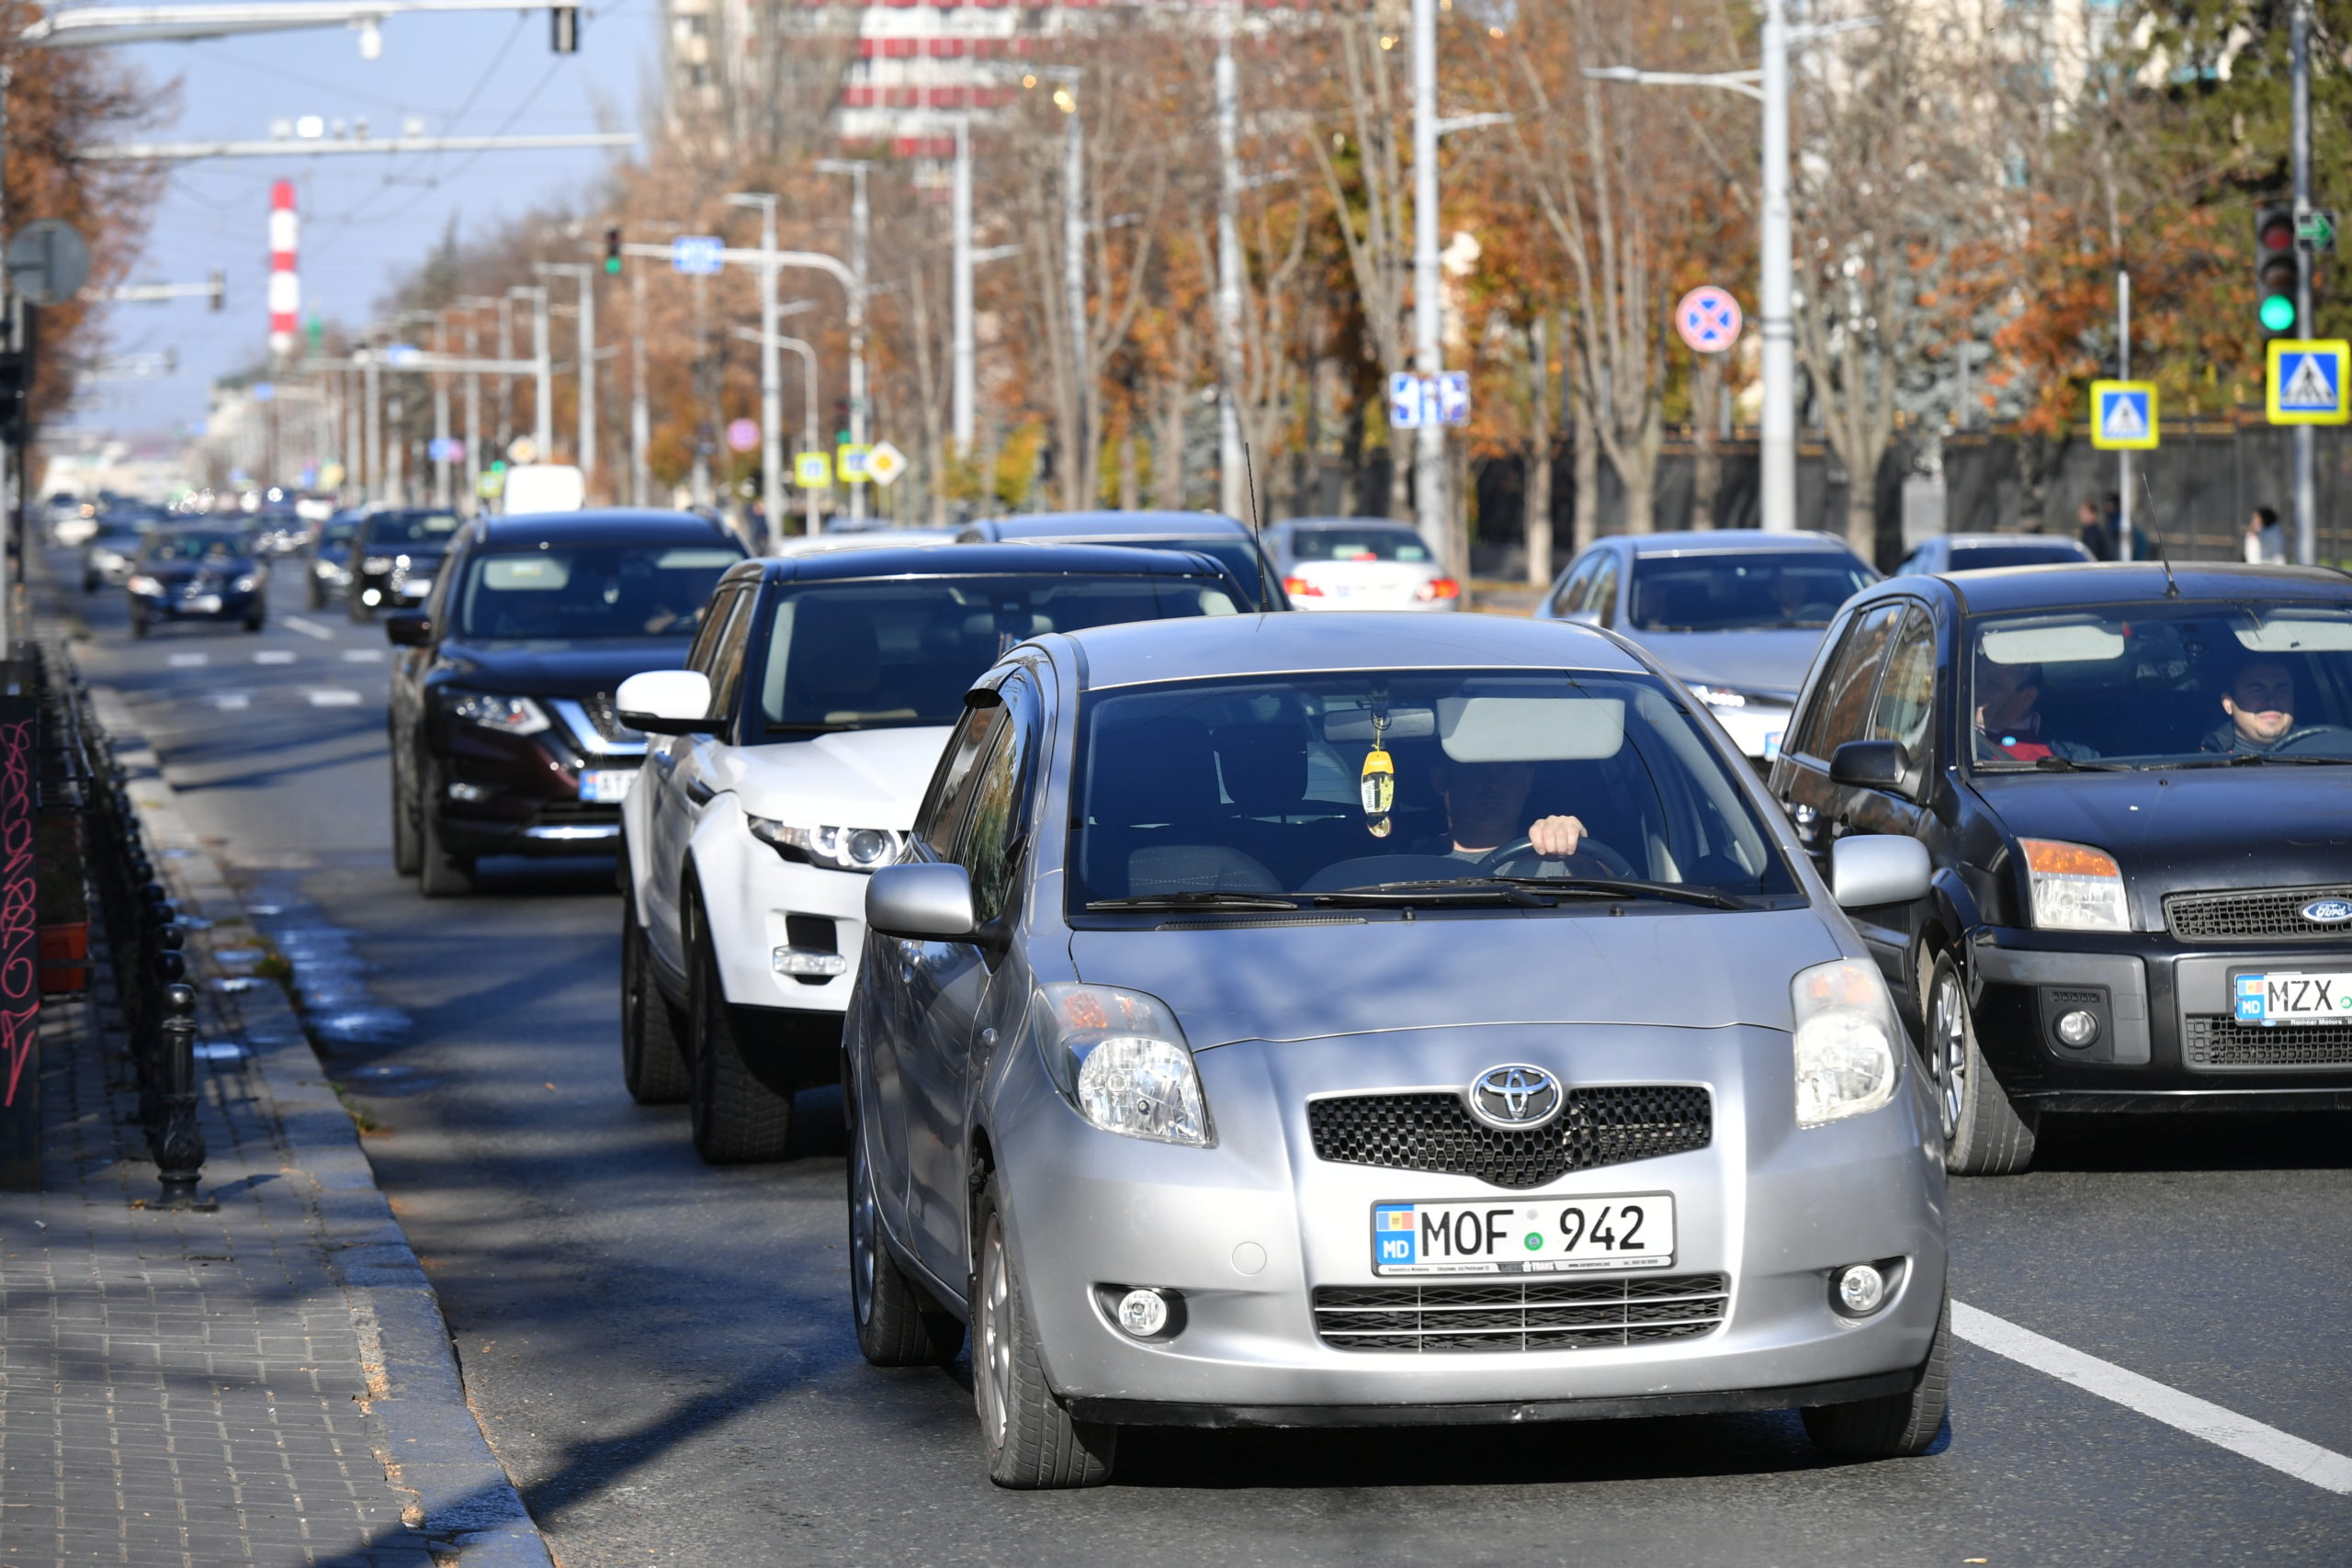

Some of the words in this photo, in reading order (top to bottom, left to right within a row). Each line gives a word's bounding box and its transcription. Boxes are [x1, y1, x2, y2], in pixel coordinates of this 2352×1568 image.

[2316, 903, 2346, 918] Ford
[2268, 980, 2333, 1011] MZX
[2243, 1000, 2260, 1014] MD
[1421, 1209, 1514, 1257] MOF
[1559, 1205, 1645, 1252] 942
[1383, 1240, 1409, 1258] MD
